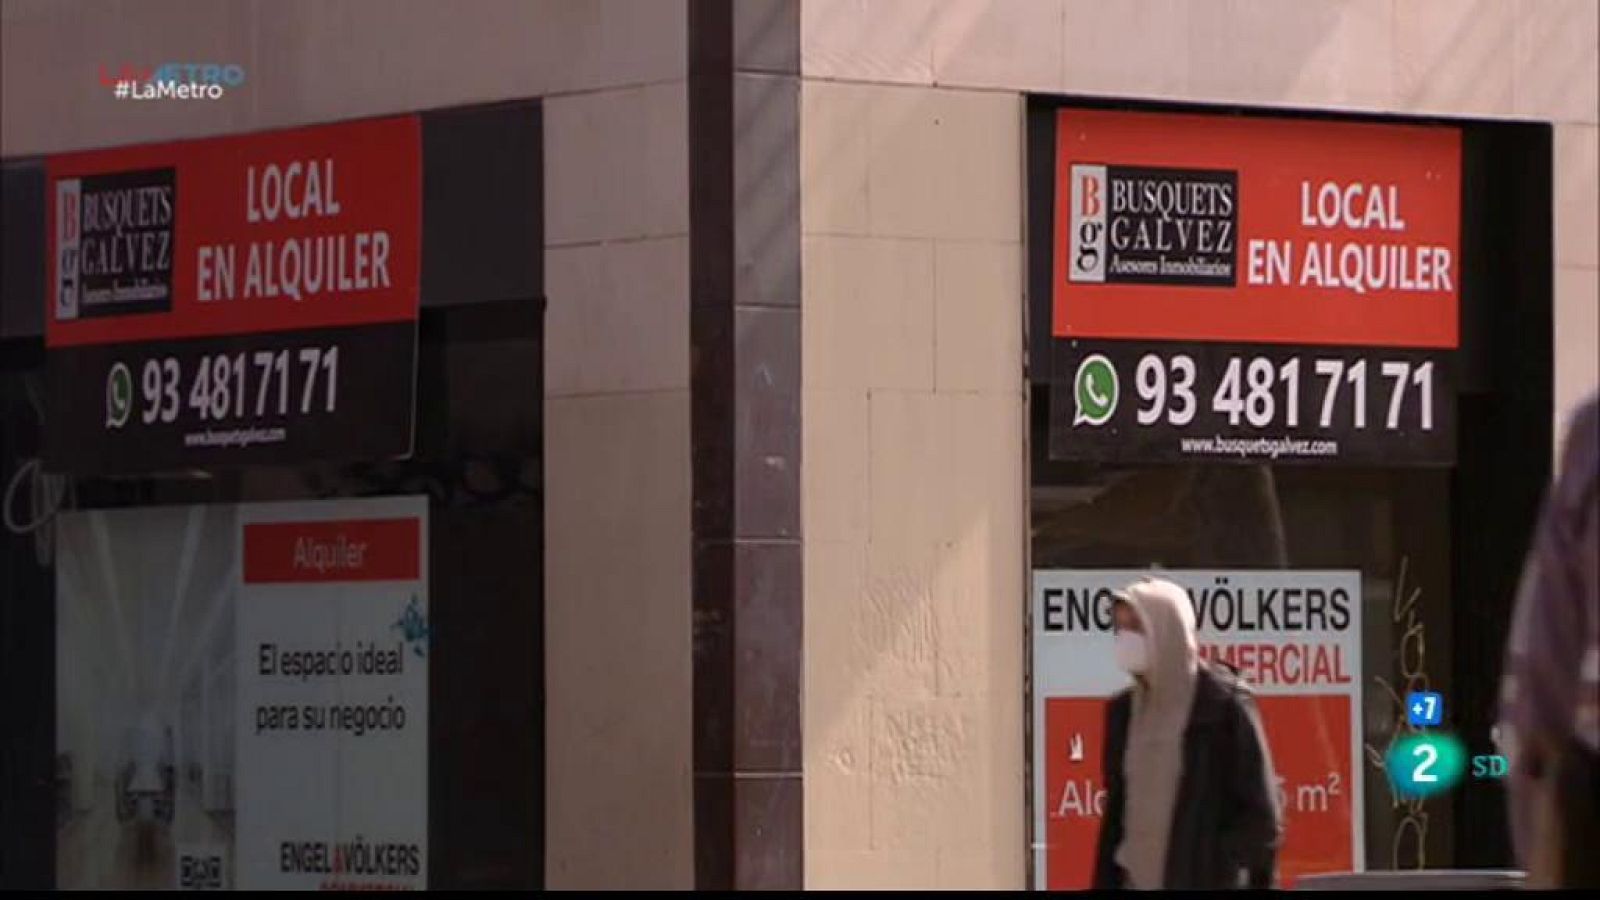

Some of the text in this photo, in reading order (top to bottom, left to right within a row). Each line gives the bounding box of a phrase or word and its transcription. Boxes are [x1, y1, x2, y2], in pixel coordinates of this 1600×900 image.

[83, 185, 172, 237] BUSQUETS
[246, 158, 341, 222] LOCAL
[1111, 178, 1233, 222] BUSQUETS
[1301, 181, 1404, 231] LOCAL
[82, 230, 170, 276] GALVEZ
[1110, 216, 1233, 254] GALVEZ
[198, 244, 236, 301] EN
[244, 231, 391, 300] ALQUILER
[1248, 239, 1453, 293] EN ALQUILER
[142, 345, 339, 424] 93 481 71 71
[1135, 354, 1434, 431] 93 481 71 71
[293, 533, 368, 575] Alquiler
[1043, 587, 1116, 633] ENG
[259, 640, 404, 682] El espacio ideal
[256, 694, 406, 737] para su negocio
